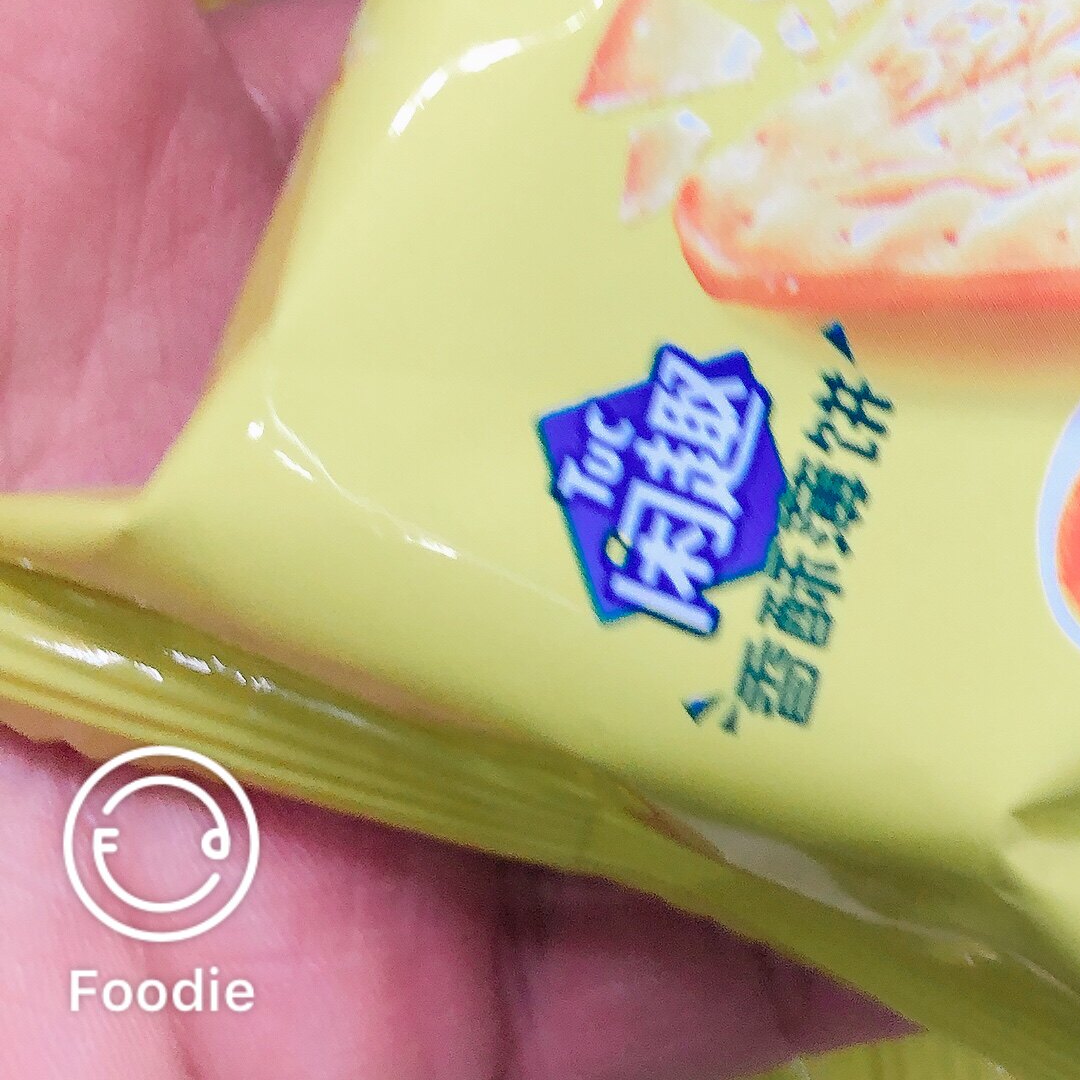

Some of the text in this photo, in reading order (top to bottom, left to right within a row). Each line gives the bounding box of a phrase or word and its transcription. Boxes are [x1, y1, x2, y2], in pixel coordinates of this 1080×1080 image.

[606, 347, 768, 636] 闲趣
[735, 371, 895, 726] 香酥薄饼
